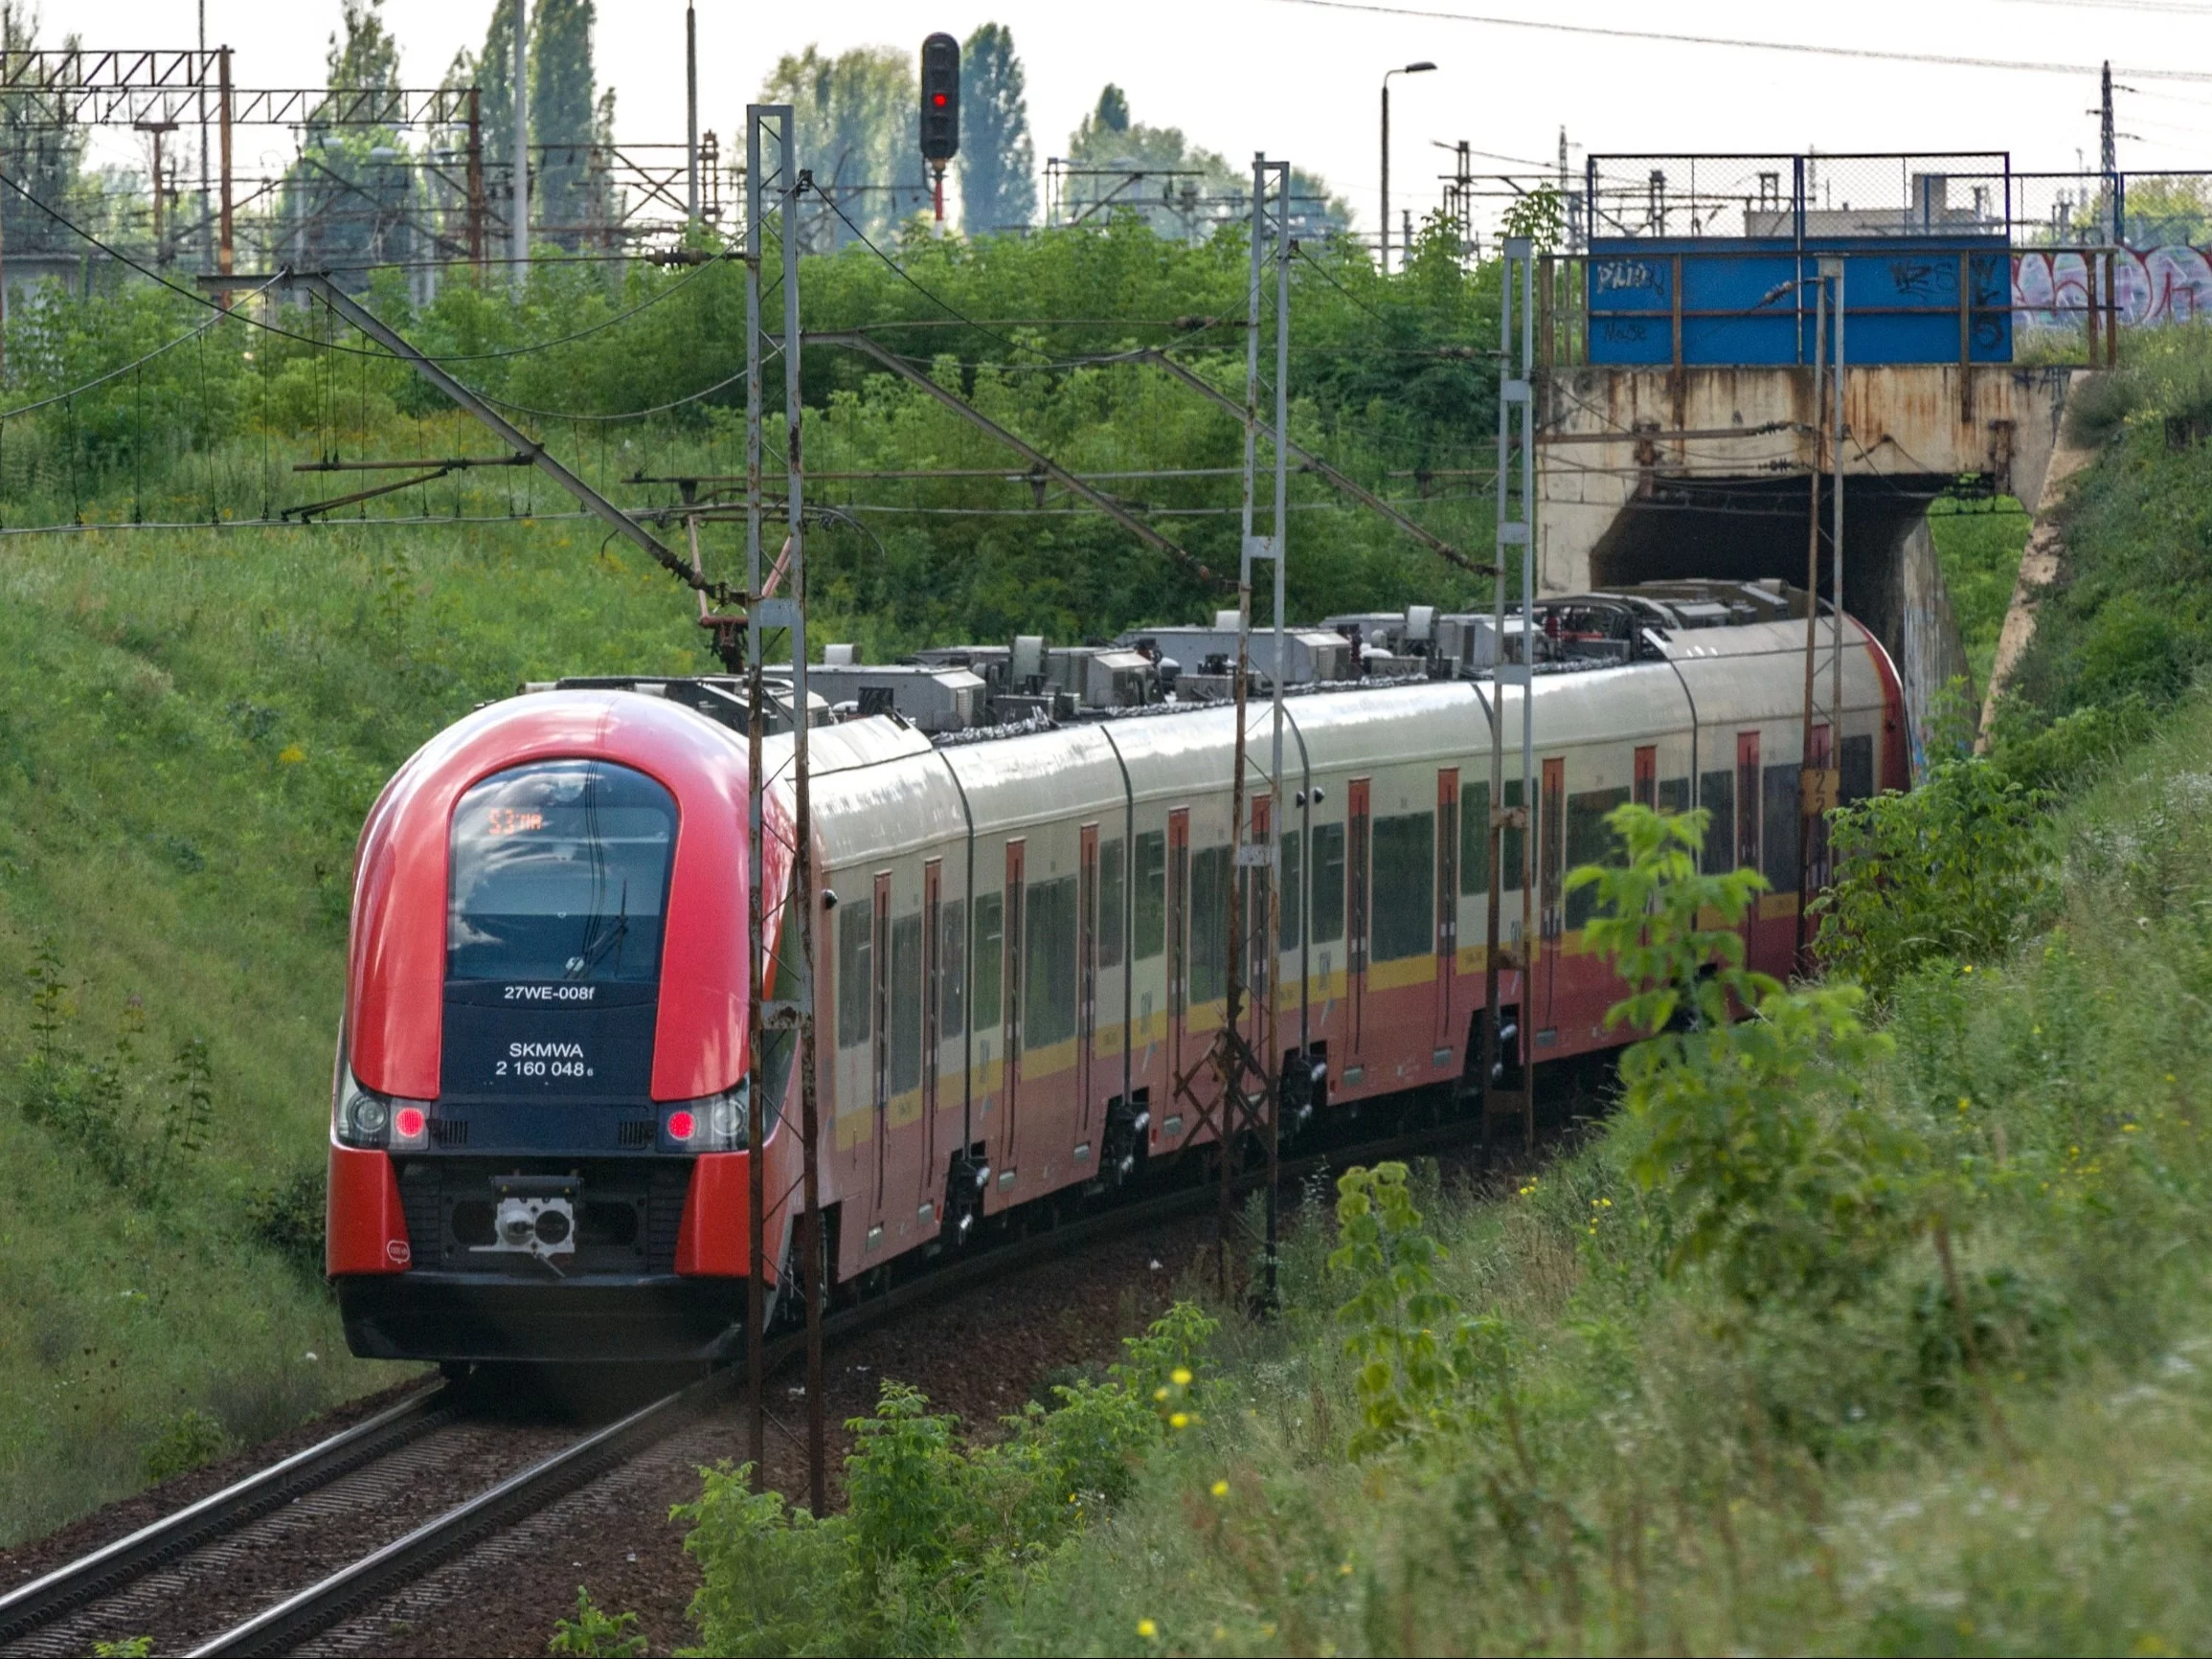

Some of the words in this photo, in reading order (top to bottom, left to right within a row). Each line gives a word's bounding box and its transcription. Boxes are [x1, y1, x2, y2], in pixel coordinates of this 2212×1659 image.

[1815, 771, 1826, 794] 2
[504, 986, 596, 1000] 27WE-008f
[508, 1042, 584, 1058] SKMWA
[495, 1061, 508, 1076] 2
[513, 1061, 546, 1076] 160
